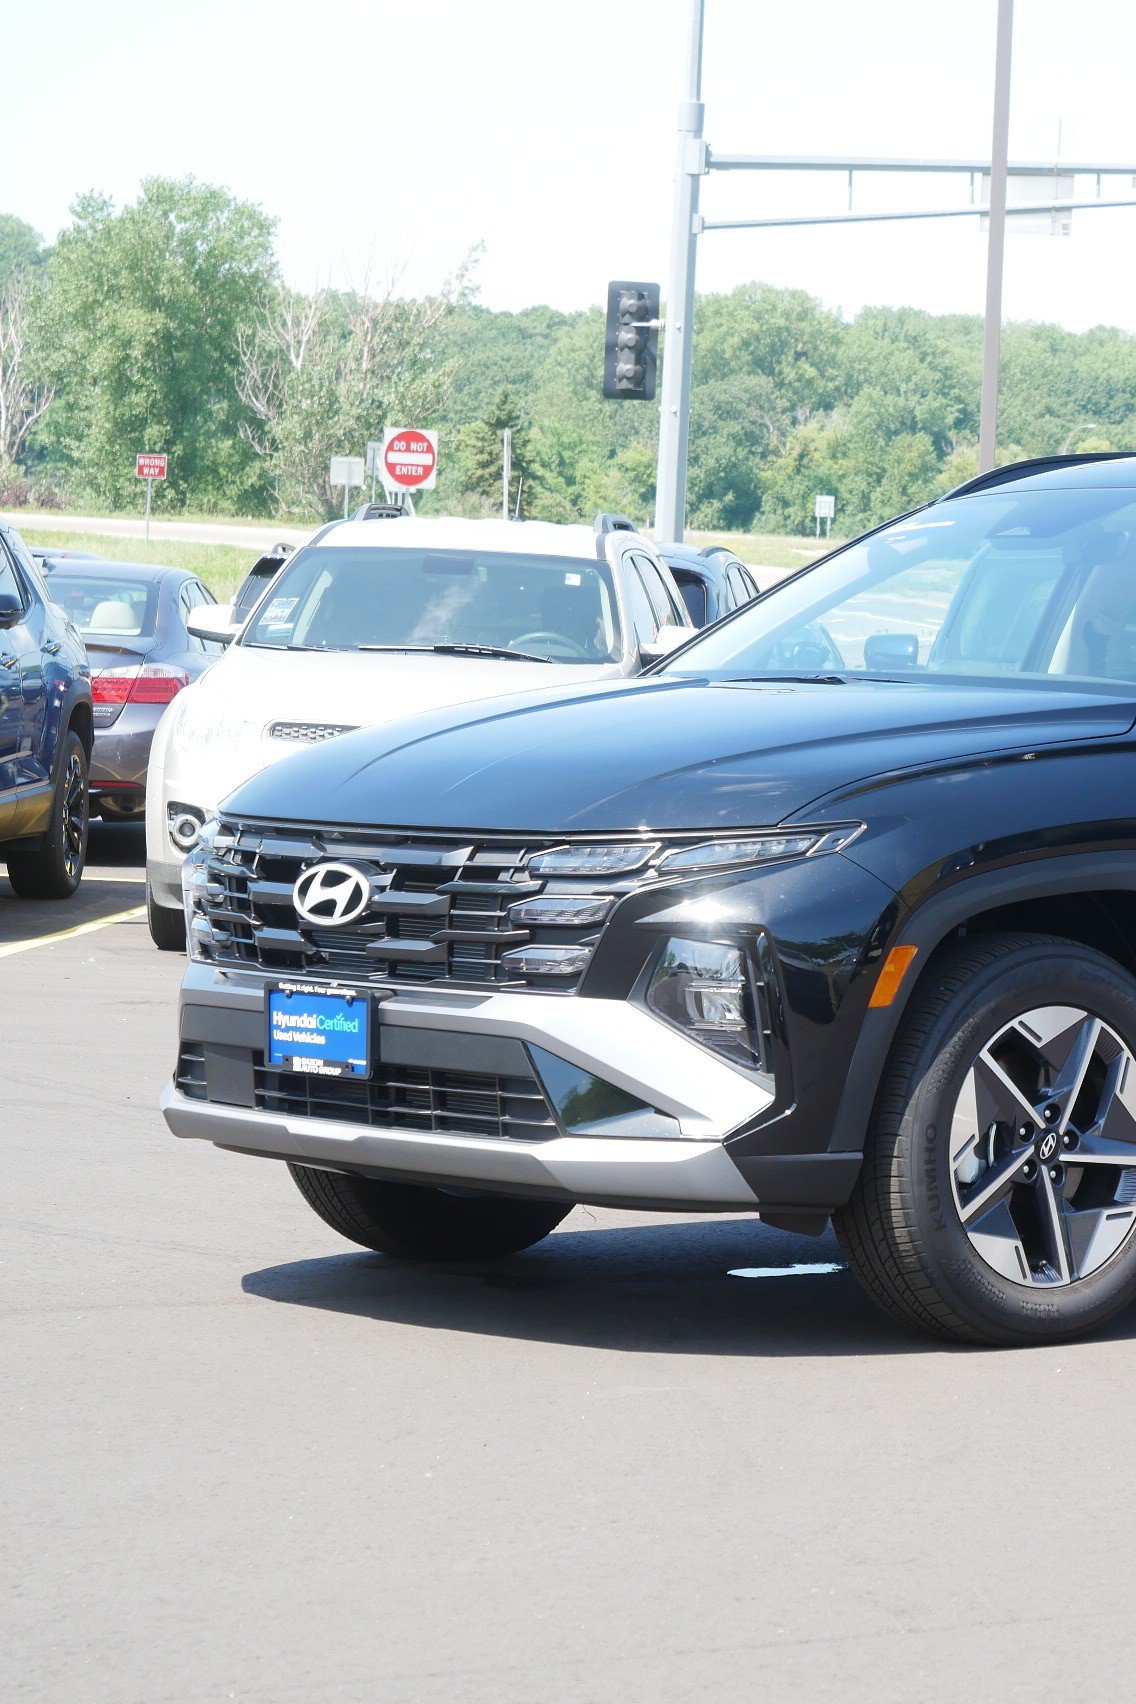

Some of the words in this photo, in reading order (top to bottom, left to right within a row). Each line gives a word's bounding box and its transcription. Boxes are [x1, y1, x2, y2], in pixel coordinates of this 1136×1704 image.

[393, 440, 406, 451] DO
[410, 441, 428, 452] NOT
[138, 458, 165, 467] WRONG
[143, 466, 160, 476] WAY
[395, 465, 424, 476] ENTER
[273, 1029, 293, 1042] Used
[293, 1031, 326, 1045] Vehicles
